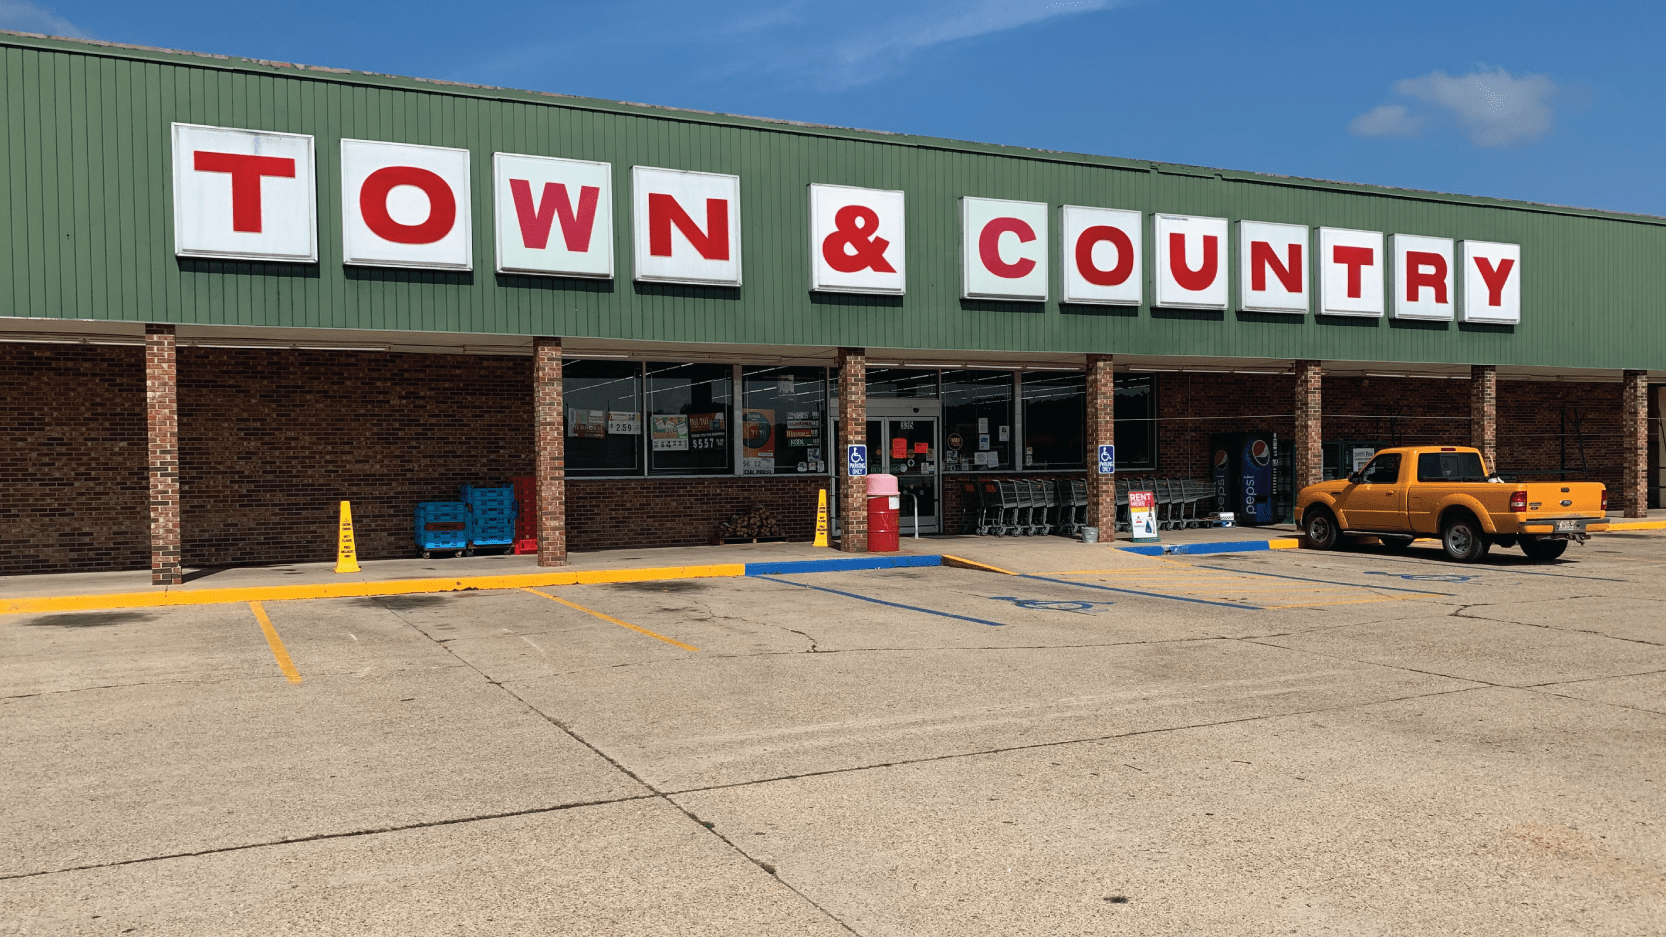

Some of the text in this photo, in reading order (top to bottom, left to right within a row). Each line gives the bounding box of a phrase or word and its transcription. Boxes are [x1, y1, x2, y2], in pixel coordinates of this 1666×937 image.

[193, 150, 1516, 308] TOWN & COUNTRY
[1129, 493, 1152, 501] RENT
[1243, 475, 1258, 514] pepsi
